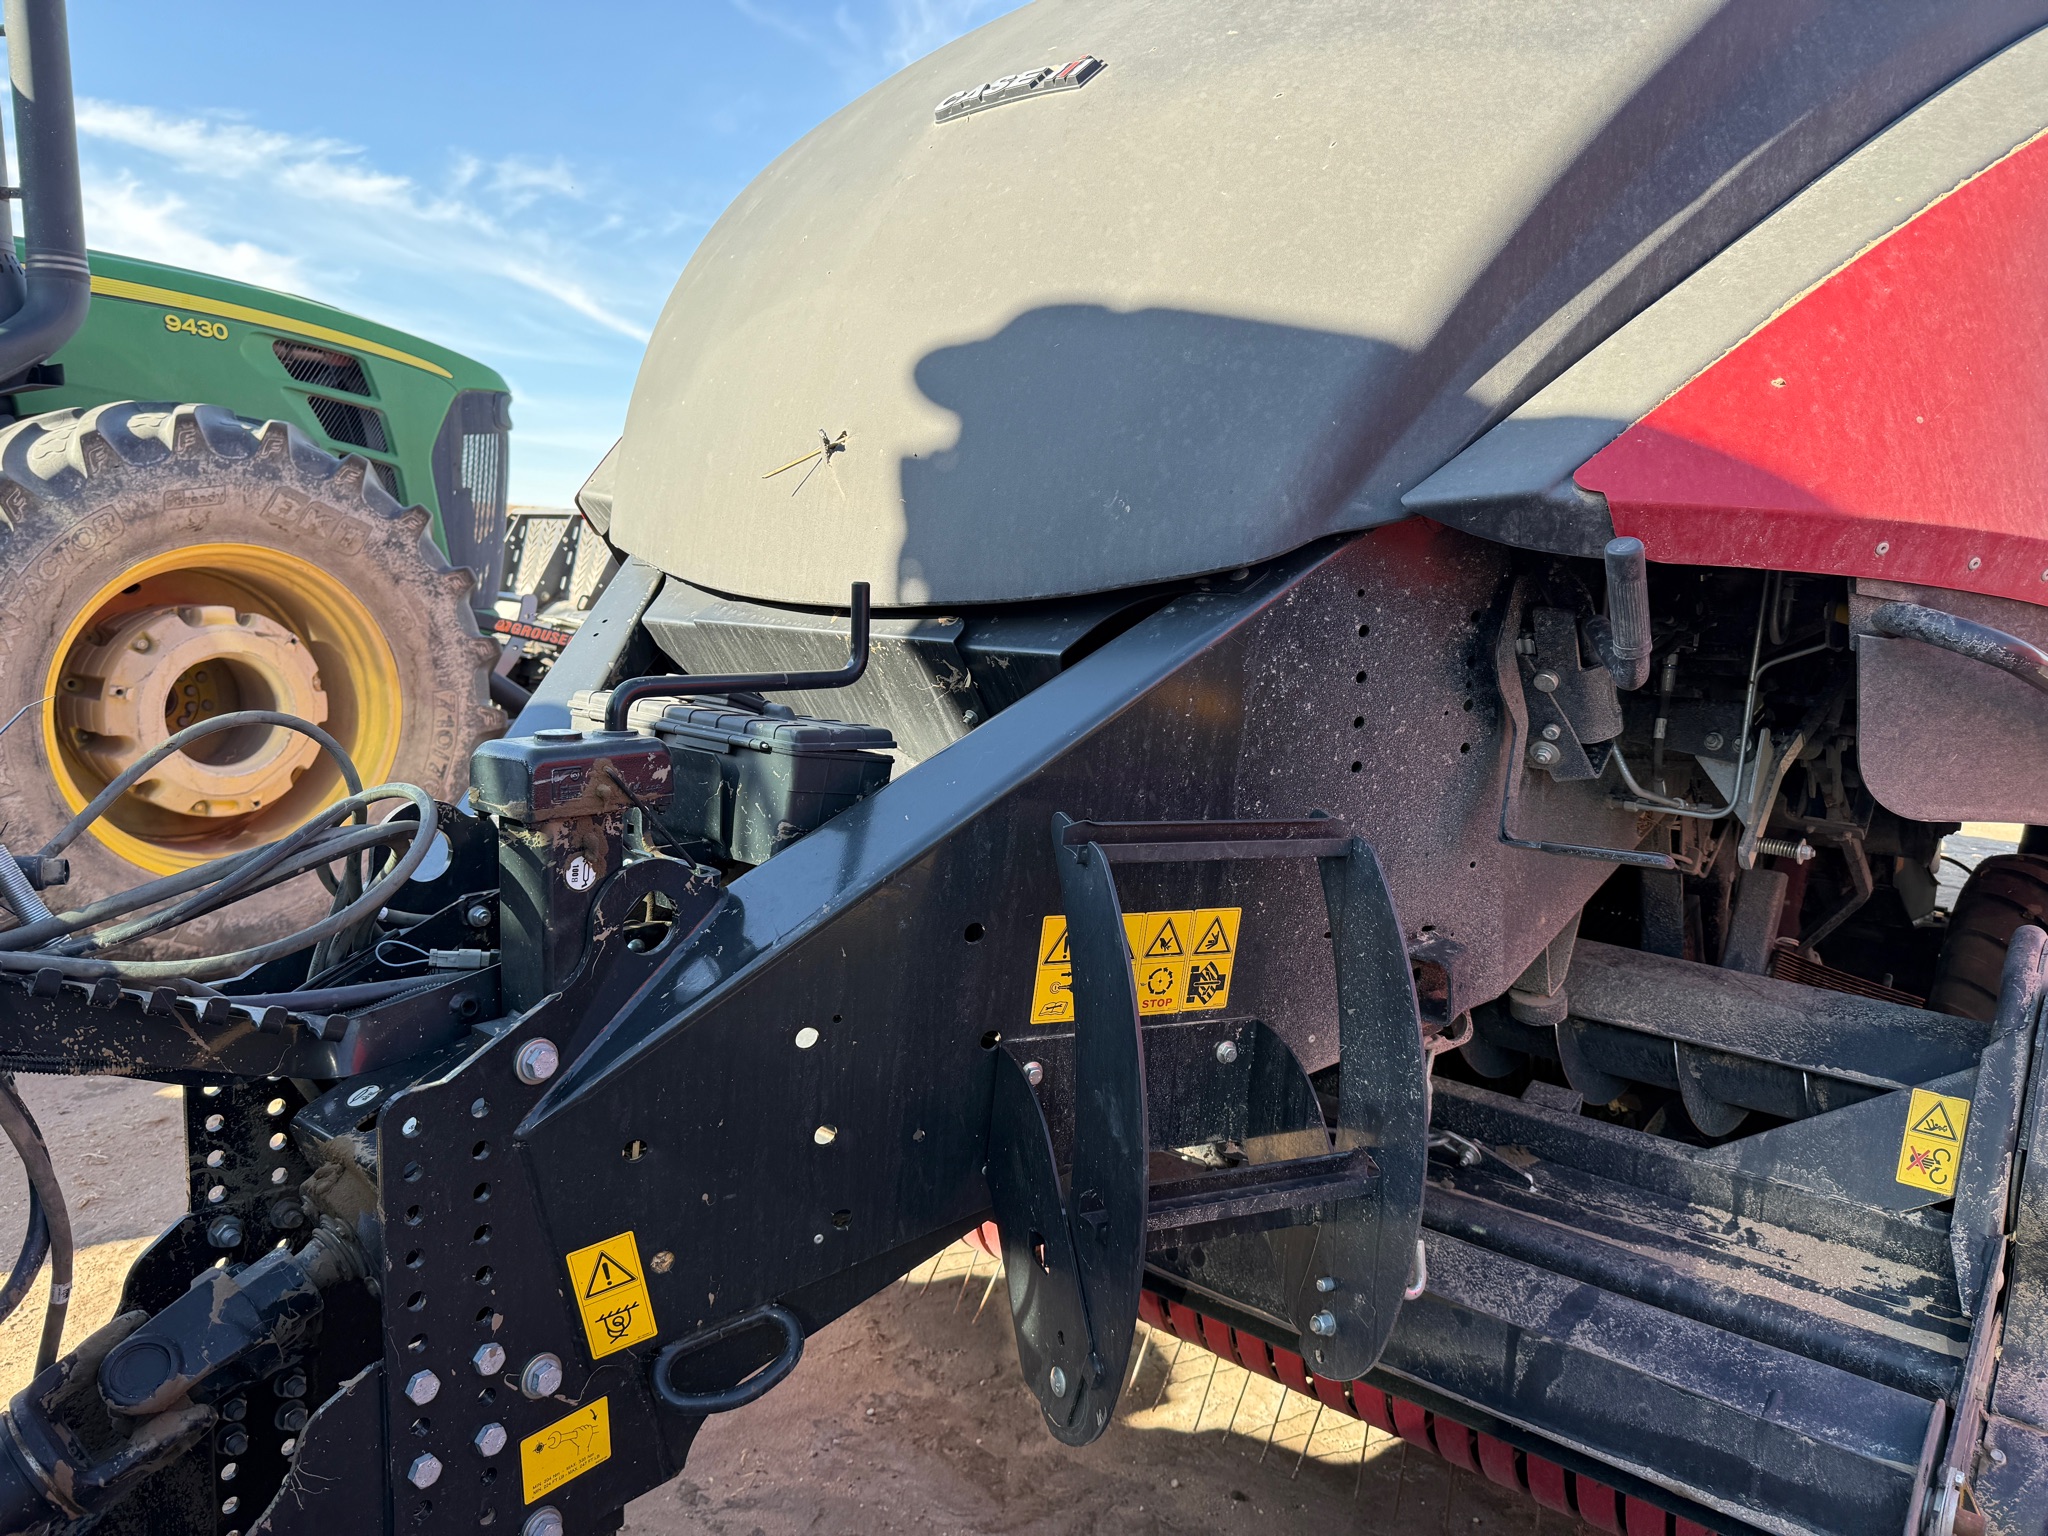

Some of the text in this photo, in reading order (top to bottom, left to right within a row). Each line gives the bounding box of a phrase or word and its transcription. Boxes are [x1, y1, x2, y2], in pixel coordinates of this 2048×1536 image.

[934, 66, 1053, 123] CASE
[164, 314, 229, 341] 9430
[1142, 997, 1173, 1009] STOP
